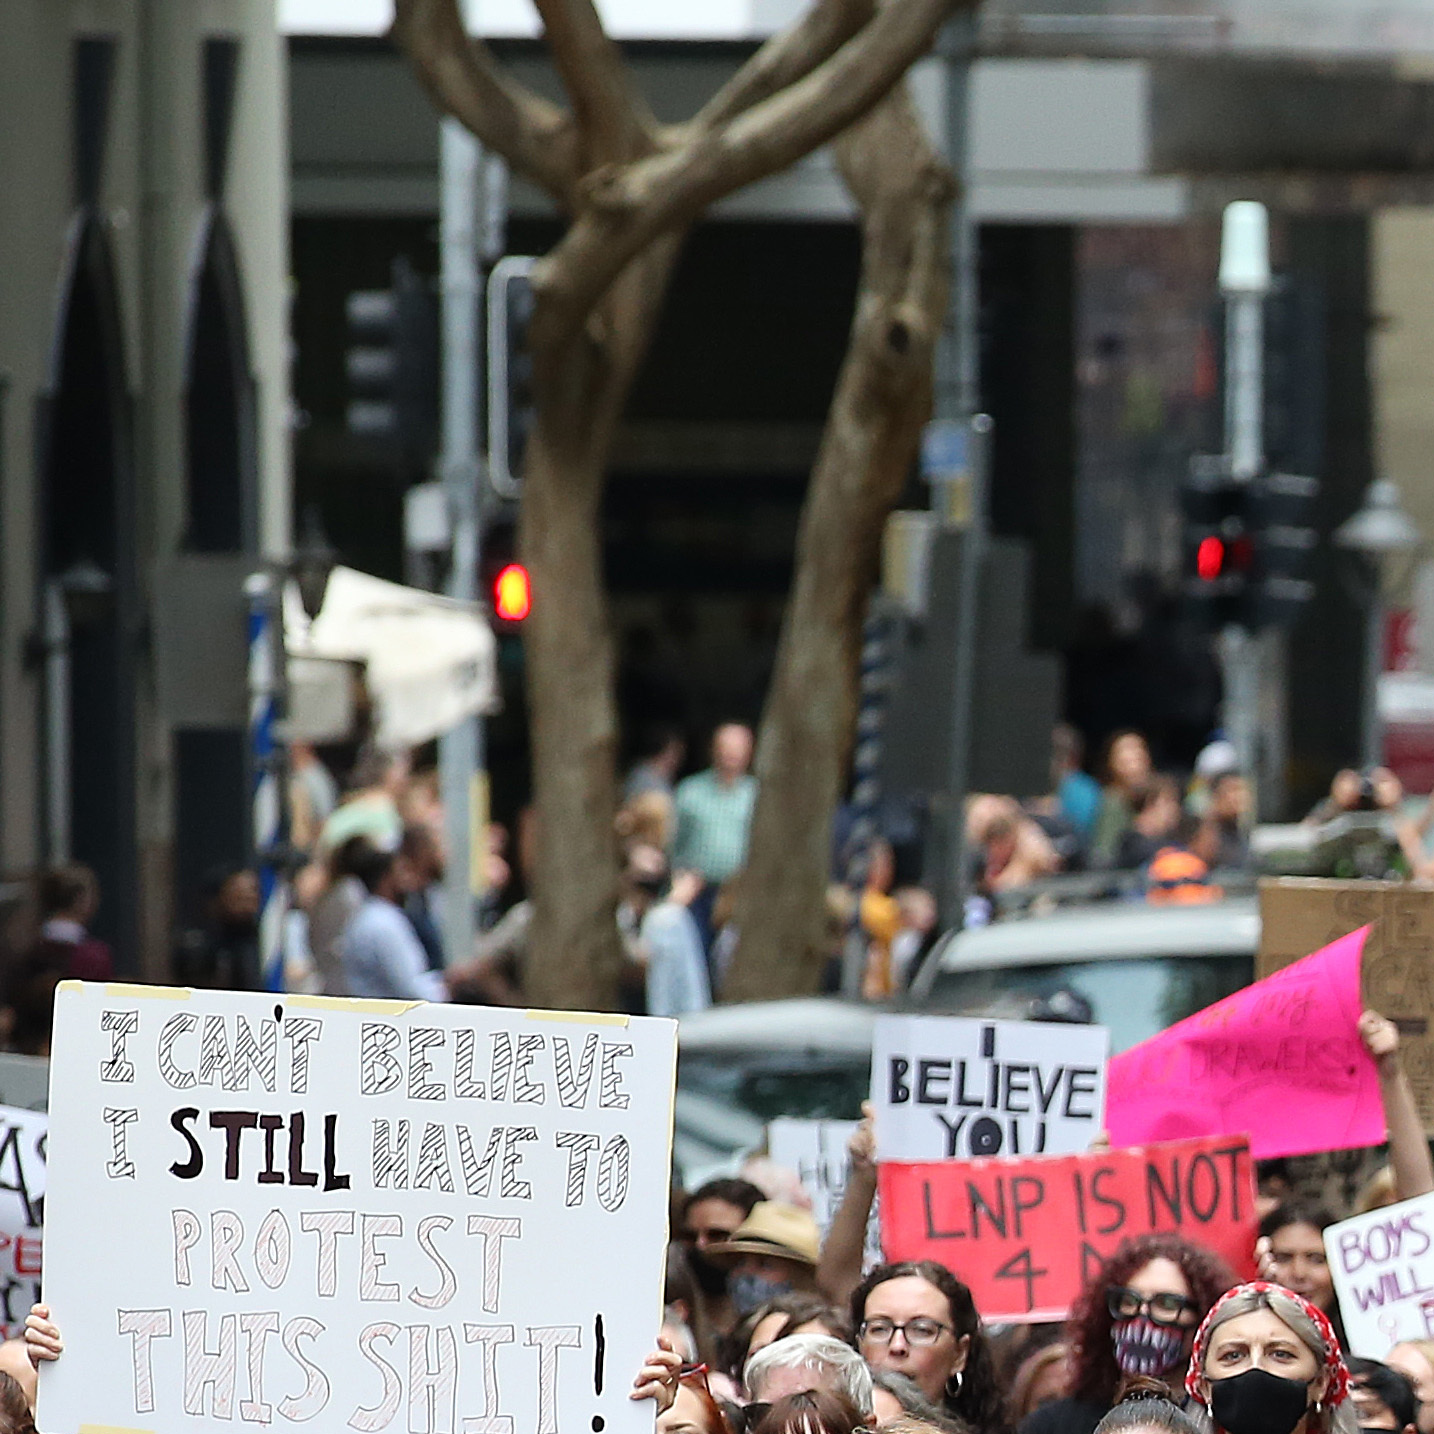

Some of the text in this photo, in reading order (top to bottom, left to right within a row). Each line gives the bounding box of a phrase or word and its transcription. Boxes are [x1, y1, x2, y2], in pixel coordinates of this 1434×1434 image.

[101, 1004, 634, 1110] I CAN'T BELIEVE
[983, 1026, 995, 1058] I
[890, 1058, 1097, 1118] BELIEVE
[104, 1107, 137, 1179] I
[169, 1107, 350, 1192] STILL
[371, 1117, 538, 1200] HAVE
[555, 1131, 630, 1213] TO
[937, 1114, 1046, 1159] YOU
[924, 1146, 1249, 1240] LNP IS NOT
[172, 1209, 522, 1313] PROTEST
[1339, 1211, 1431, 1273] BOYS
[994, 1247, 1047, 1311] 4
[1353, 1268, 1433, 1311] WILL
[117, 1308, 330, 1425] THIS
